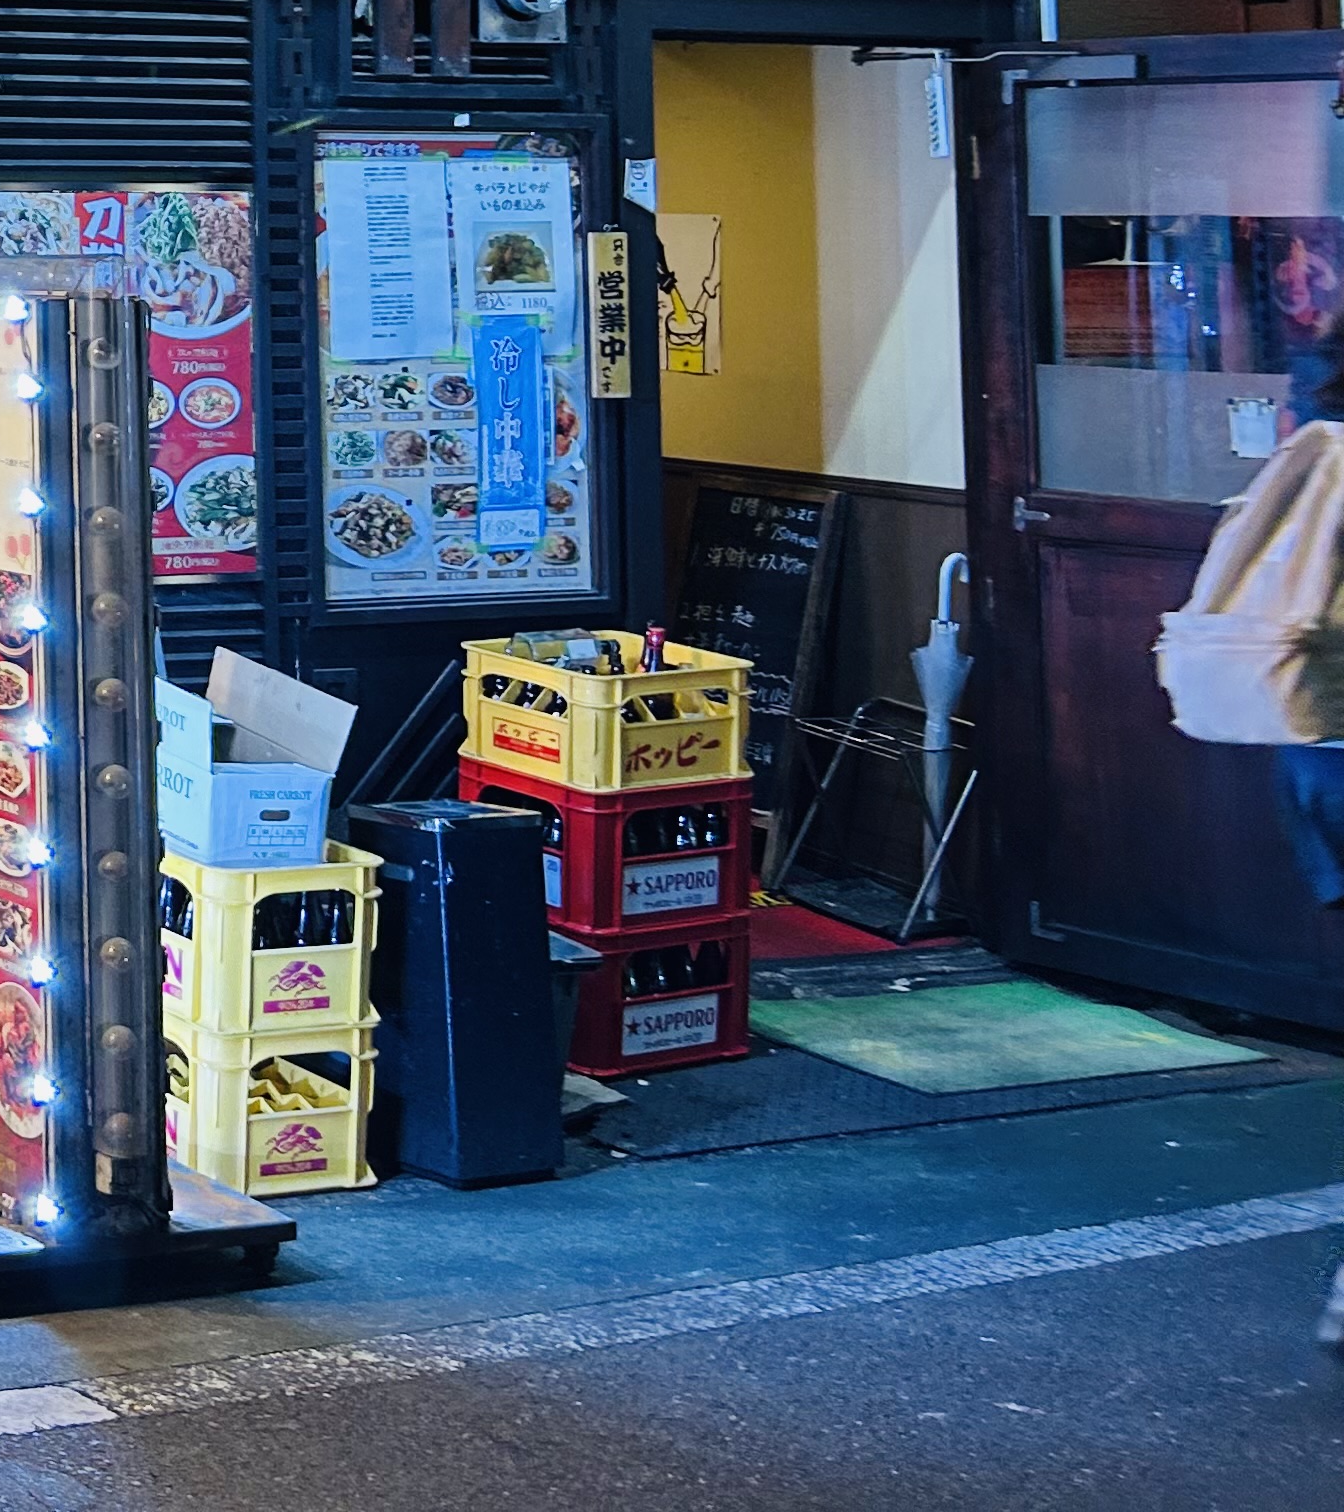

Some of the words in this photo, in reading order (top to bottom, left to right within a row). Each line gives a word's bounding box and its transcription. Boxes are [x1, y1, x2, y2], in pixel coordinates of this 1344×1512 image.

[597, 269, 627, 366] 営業中
[496, 721, 558, 744] ホッピー
[625, 731, 722, 774] ホッピー
[643, 868, 717, 897] SAPPORO
[643, 1006, 716, 1036] SAPPORO
